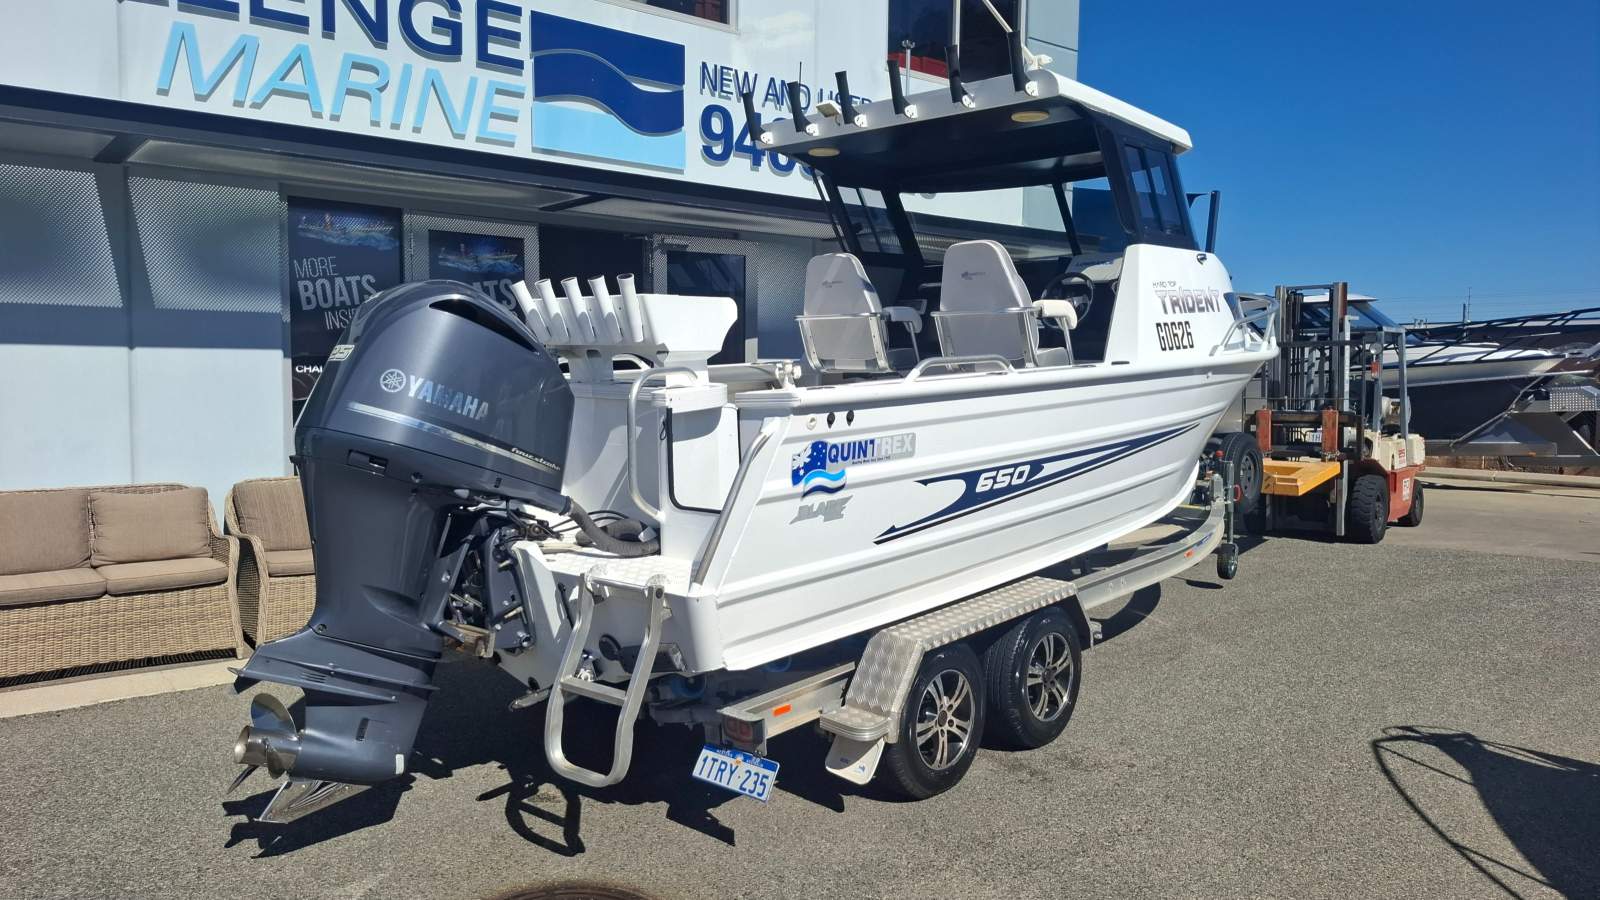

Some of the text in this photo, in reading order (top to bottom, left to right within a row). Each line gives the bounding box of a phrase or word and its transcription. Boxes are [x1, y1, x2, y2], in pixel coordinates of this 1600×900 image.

[156, 20, 527, 148] MARINE
[700, 61, 758, 103] NEW
[294, 256, 338, 279] MORE
[297, 274, 377, 311] BOATS
[1154, 286, 1221, 315] TRIDENT
[324, 308, 358, 330] INSI
[408, 374, 489, 420] YAMAHA
[827, 433, 914, 464] QUINTREX
[975, 464, 1031, 493] 650
